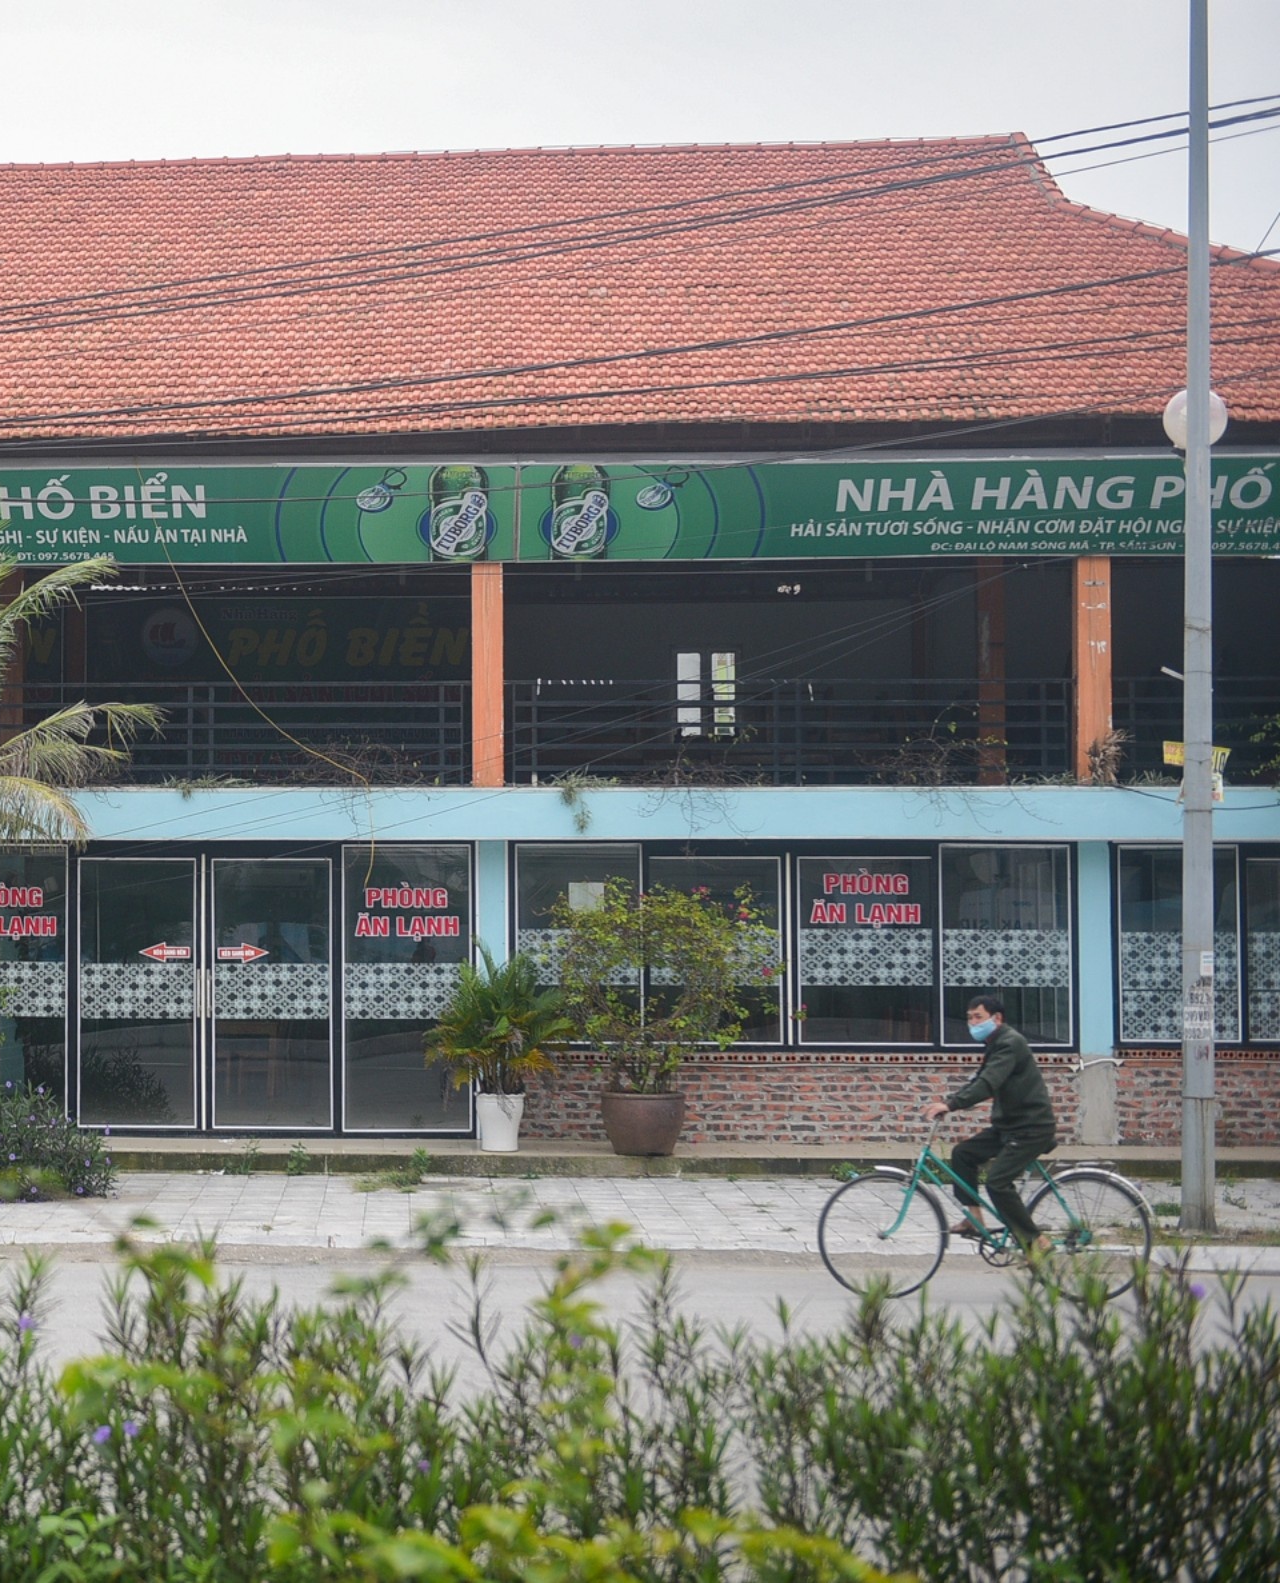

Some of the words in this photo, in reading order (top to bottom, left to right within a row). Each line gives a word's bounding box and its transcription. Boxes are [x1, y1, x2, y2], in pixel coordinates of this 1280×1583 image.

[89, 472, 207, 519] BIỂN
[836, 470, 954, 512] NHÀ
[971, 469, 1136, 510] HÀNG
[36, 528, 59, 548] SỰ
[62, 526, 100, 547] KIỆN
[114, 525, 149, 544] NẤU
[154, 526, 178, 543] ĂN
[180, 529, 206, 547] TẠI
[211, 525, 248, 543] NHÀ
[436, 505, 480, 551] TUBORG
[556, 505, 601, 550] TUBORG
[790, 518, 822, 537] HẢI
[825, 518, 862, 537] SẢN
[865, 520, 909, 536] TƯƠI
[912, 516, 963, 535] SỐNG
[977, 517, 1030, 538] NHẬN
[1033, 518, 1075, 534] CƠM
[1079, 516, 1116, 538] ĐẶT
[1118, 517, 1152, 537] HỘI
[998, 542, 1028, 550] NAM
[1212, 541, 1280, 550] 097.5678.4
[366, 881, 448, 908] PHÒNG
[823, 867, 909, 895] PHÒNG
[355, 912, 389, 936] ĂN
[396, 916, 460, 942] LẠNH
[810, 899, 846, 923] ĂN
[855, 903, 921, 928] LẠNH
